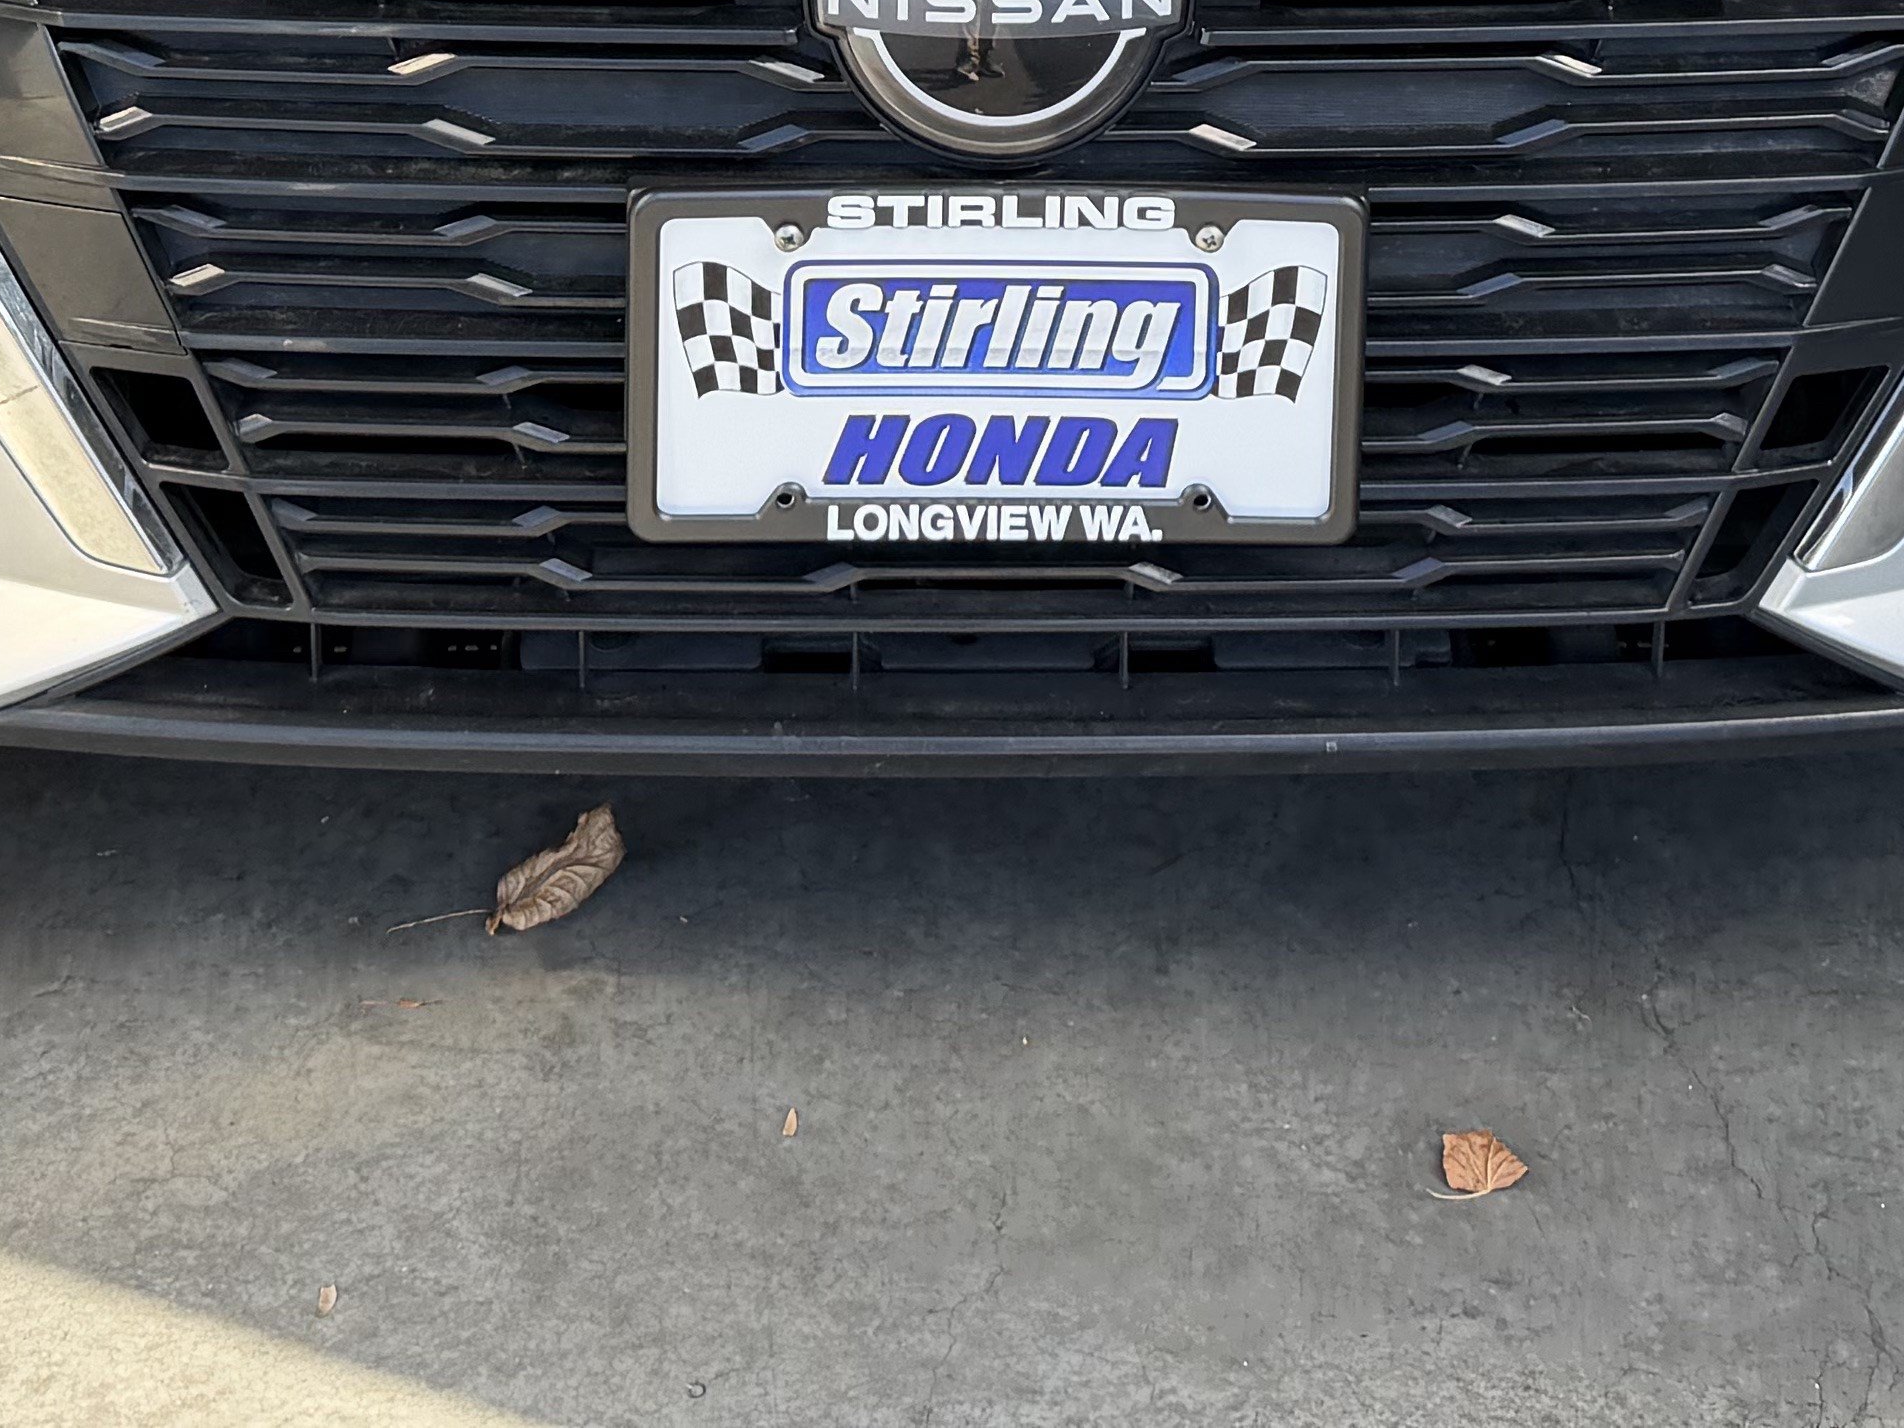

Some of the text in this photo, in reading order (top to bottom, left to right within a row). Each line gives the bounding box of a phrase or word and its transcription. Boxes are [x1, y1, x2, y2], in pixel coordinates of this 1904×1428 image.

[825, 194, 1177, 230] STIRLING
[814, 282, 1183, 385] Stirling
[821, 414, 1180, 488] HONDA
[826, 505, 1163, 541] LONGVIEW WA.
